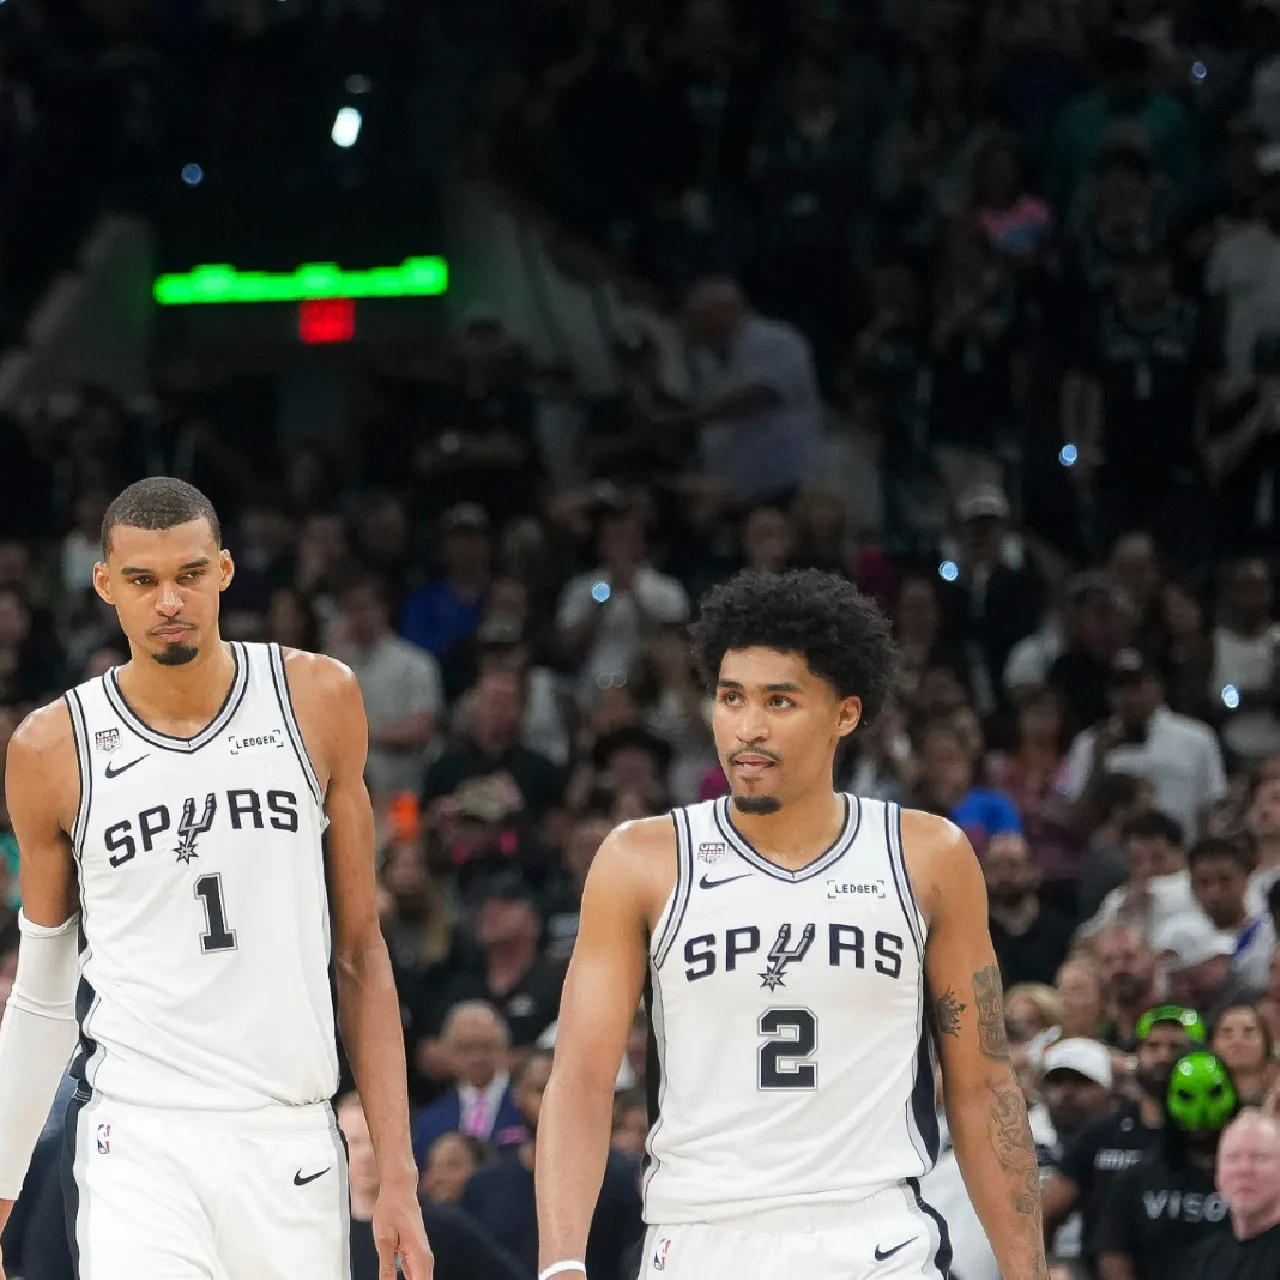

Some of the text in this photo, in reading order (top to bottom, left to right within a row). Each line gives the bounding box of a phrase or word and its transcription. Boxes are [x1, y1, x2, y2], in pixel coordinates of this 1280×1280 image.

[236, 735, 276, 748] LEDGER
[104, 789, 298, 868] SPURS
[193, 872, 238, 954] 1
[834, 883, 878, 894] LEDGER
[683, 923, 904, 993] SPURS
[756, 1006, 819, 1092] 2
